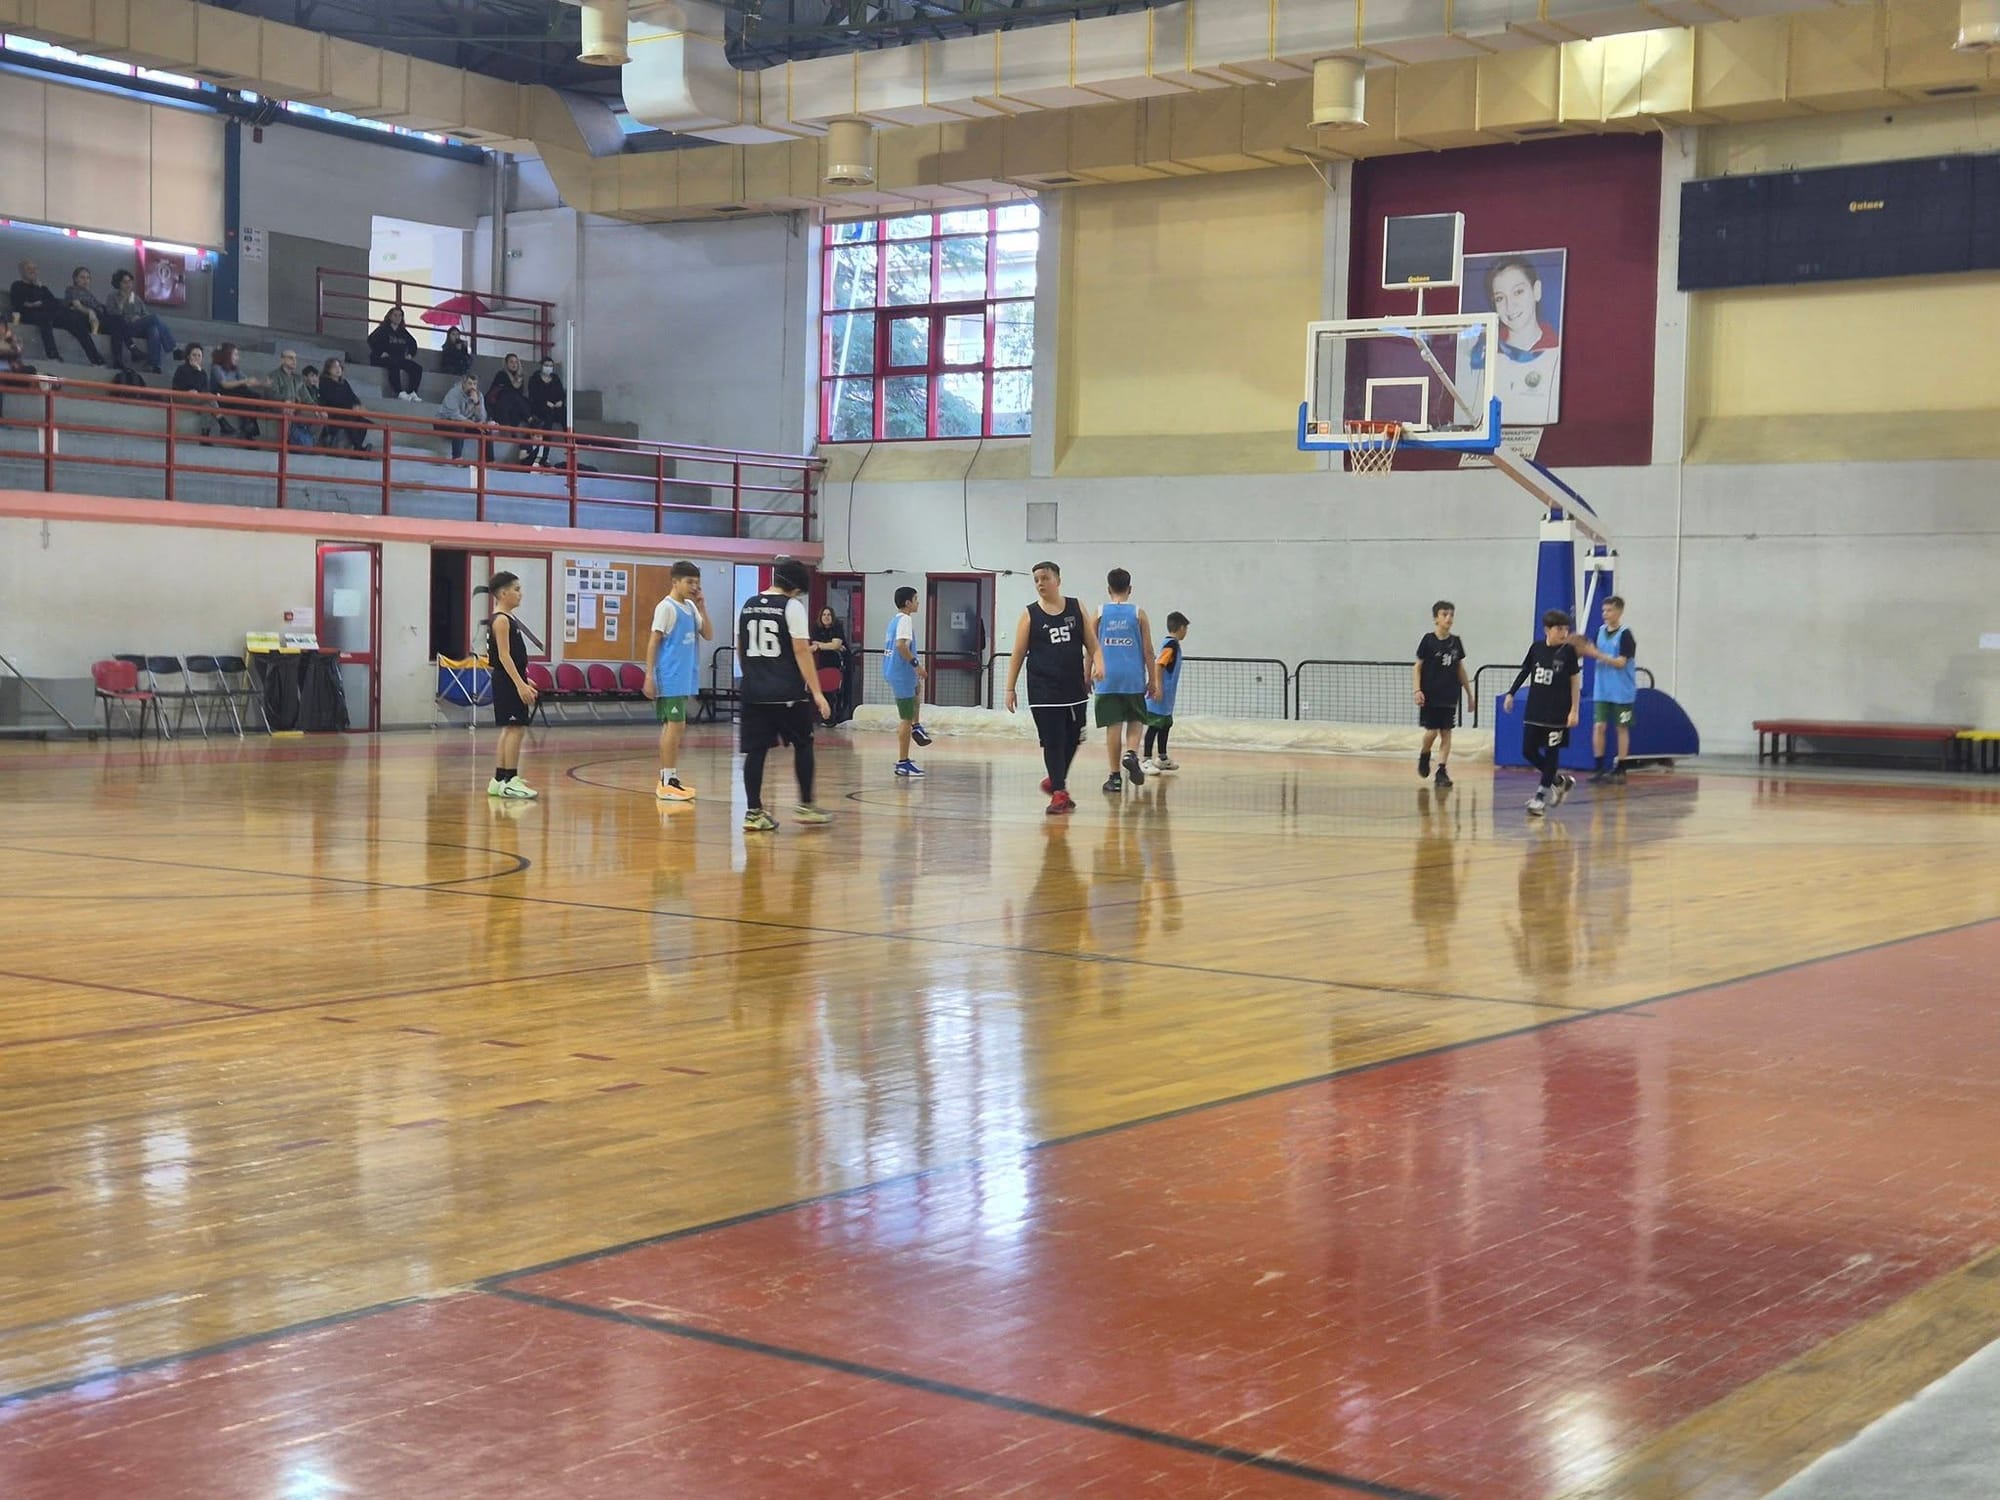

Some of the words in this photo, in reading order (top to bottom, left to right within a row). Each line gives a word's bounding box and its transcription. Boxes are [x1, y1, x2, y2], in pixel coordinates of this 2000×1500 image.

[746, 619, 782, 657] 16
[1049, 625, 1071, 644] 25
[1534, 667, 1554, 685] 28
